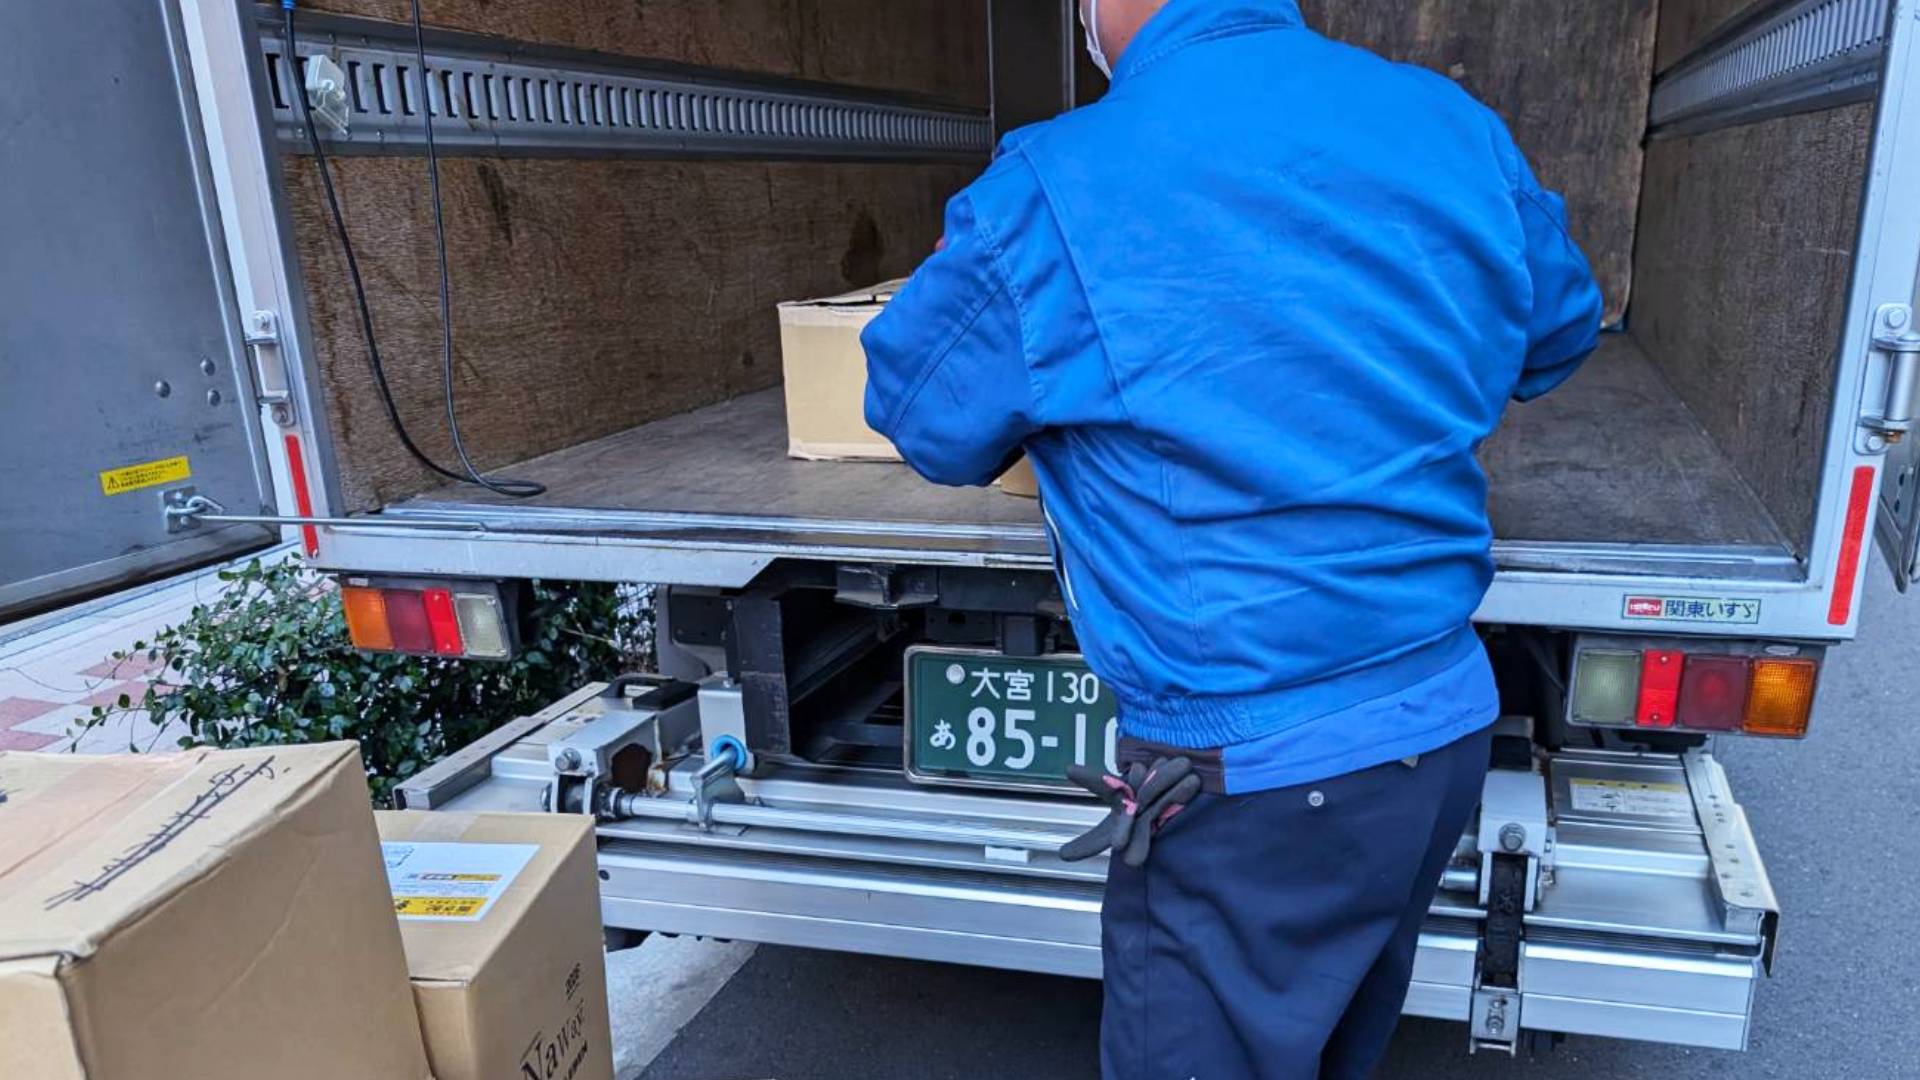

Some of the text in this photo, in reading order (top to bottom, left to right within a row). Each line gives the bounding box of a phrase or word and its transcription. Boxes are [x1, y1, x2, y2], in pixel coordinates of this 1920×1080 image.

[970, 667, 1100, 705] 大宮 130
[929, 718, 957, 751] あ
